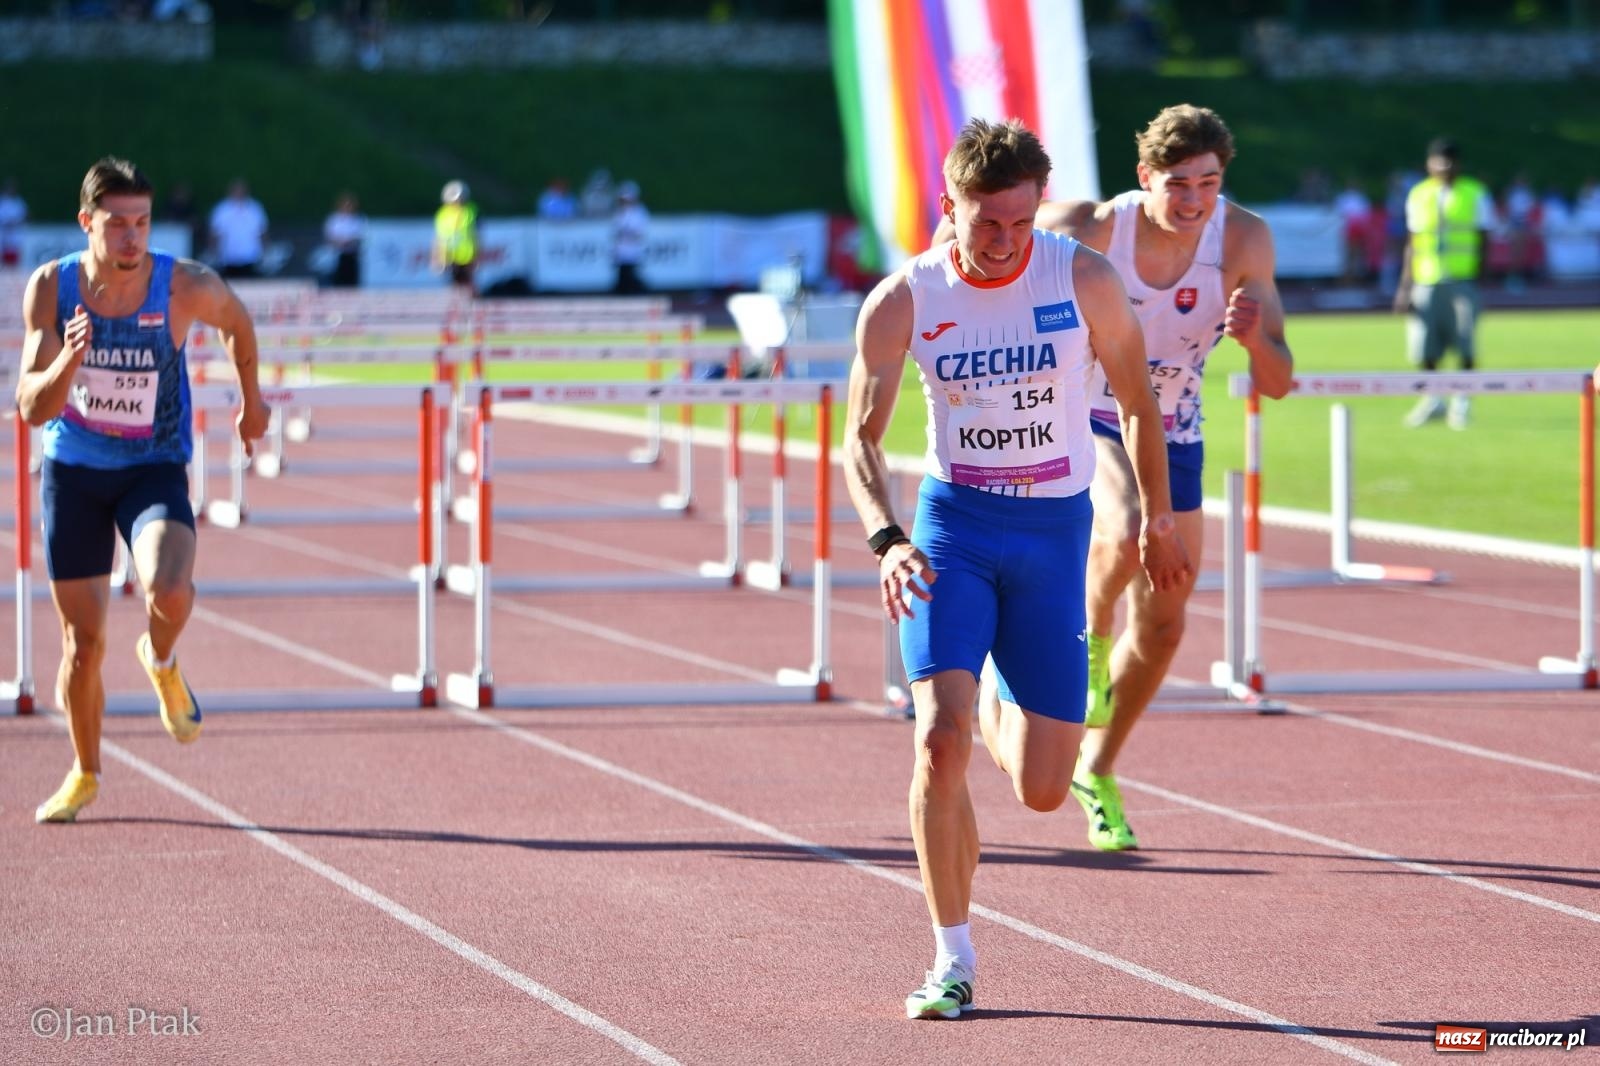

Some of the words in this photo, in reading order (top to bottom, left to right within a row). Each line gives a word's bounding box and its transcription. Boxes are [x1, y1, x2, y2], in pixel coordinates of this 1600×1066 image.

[84, 347, 155, 368] ROATIA
[936, 343, 1057, 382] CZECHIA
[115, 376, 149, 390] 553
[84, 395, 142, 414] UMAK
[1012, 387, 1054, 410] 154
[959, 421, 1054, 450] KOPTÍK
